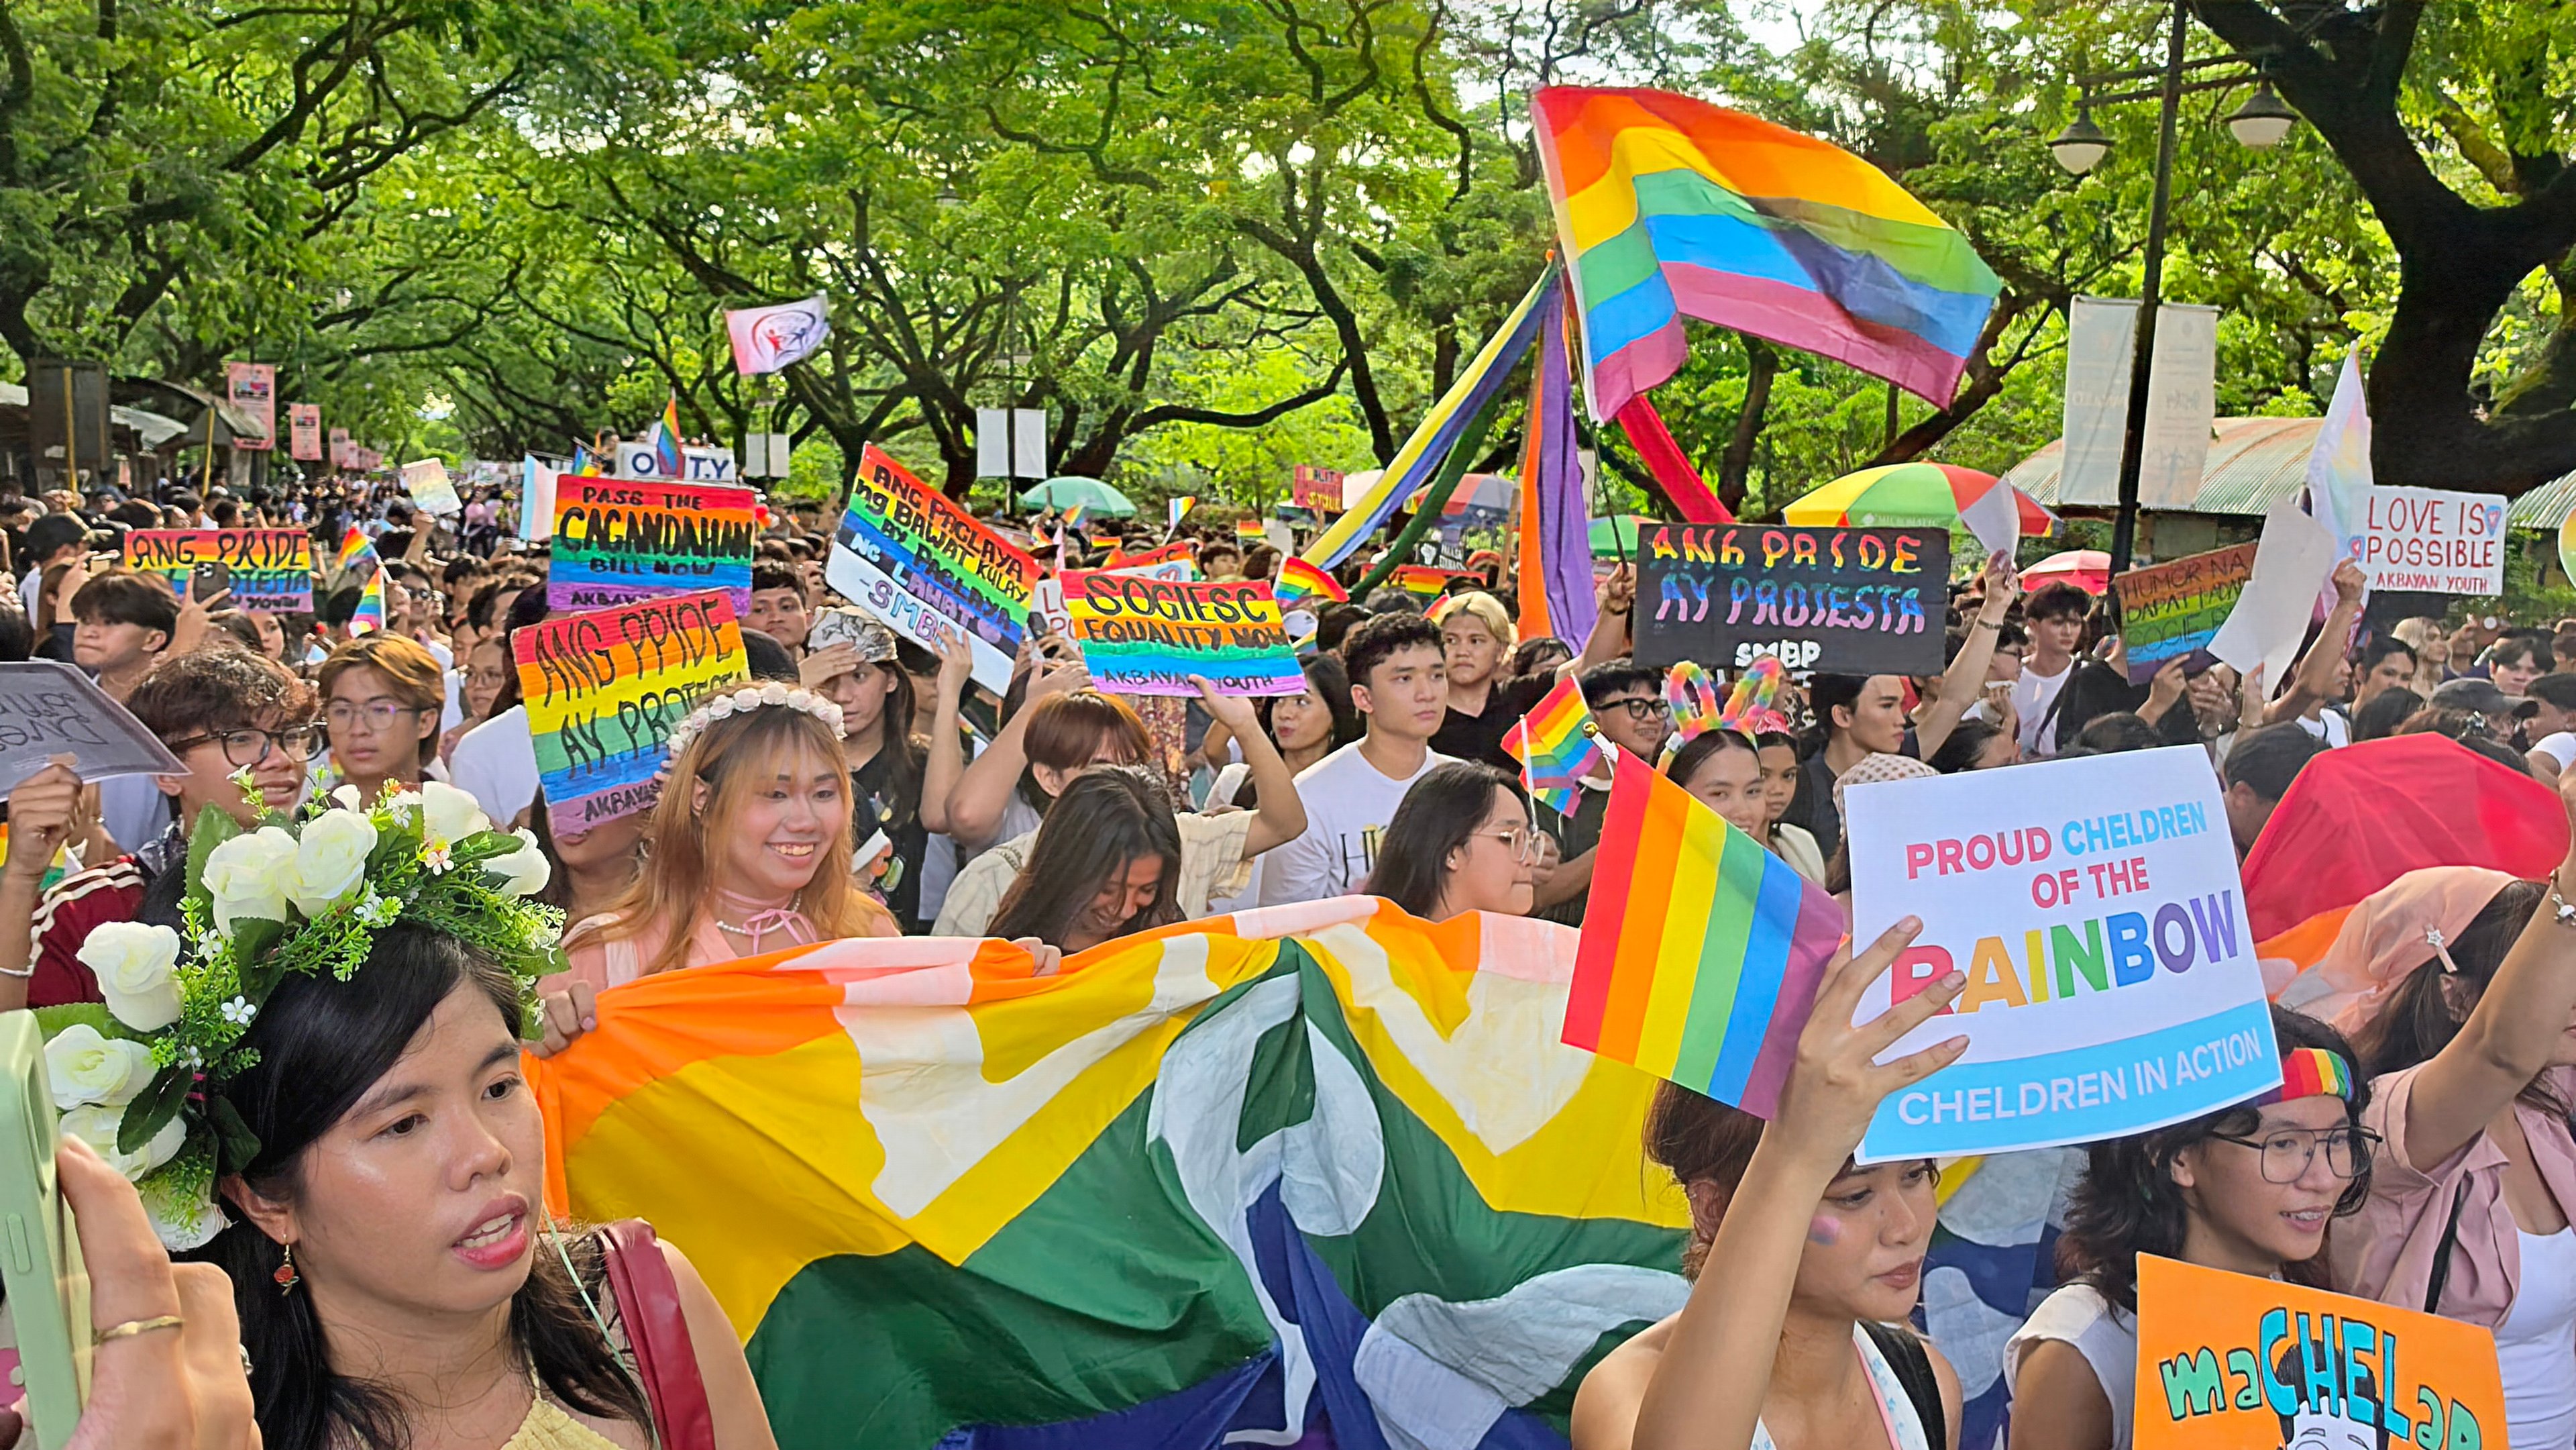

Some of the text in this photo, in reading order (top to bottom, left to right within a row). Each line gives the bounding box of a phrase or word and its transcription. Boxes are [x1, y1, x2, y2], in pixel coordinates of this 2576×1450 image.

[663, 494, 704, 510] THE
[2368, 495, 2485, 535] LOVE IS
[131, 531, 308, 568] ANG PRIDE
[894, 500, 975, 566] BAWAT
[976, 560, 1028, 602] KULAY
[929, 497, 1023, 582] PAGLAYA
[1649, 527, 1923, 574] ANG PRIDE
[2367, 535, 2495, 568] POSSIBLE
[590, 558, 716, 576] BILL NOW
[2210, 551, 2248, 576] NA
[2376, 572, 2488, 592] AKBAYAN YOUTH
[571, 590, 651, 605] AKBAY
[1084, 575, 1268, 623] SOGIESC
[1655, 572, 1925, 635] AY PROTESTA
[2126, 592, 2188, 624] DAPAT
[1084, 619, 1222, 652] EQUALITY
[1231, 626, 1289, 650] NOW
[535, 619, 616, 708] ANG
[1210, 674, 1274, 690] YOUTH
[560, 707, 605, 780] AY
[1906, 801, 2208, 880] PROUD CHELDREN
[2031, 857, 2150, 909] OF THE
[1890, 890, 2238, 1017] RAINBOW
[1898, 1027, 2263, 1126] CHELDREN IN ACTION
